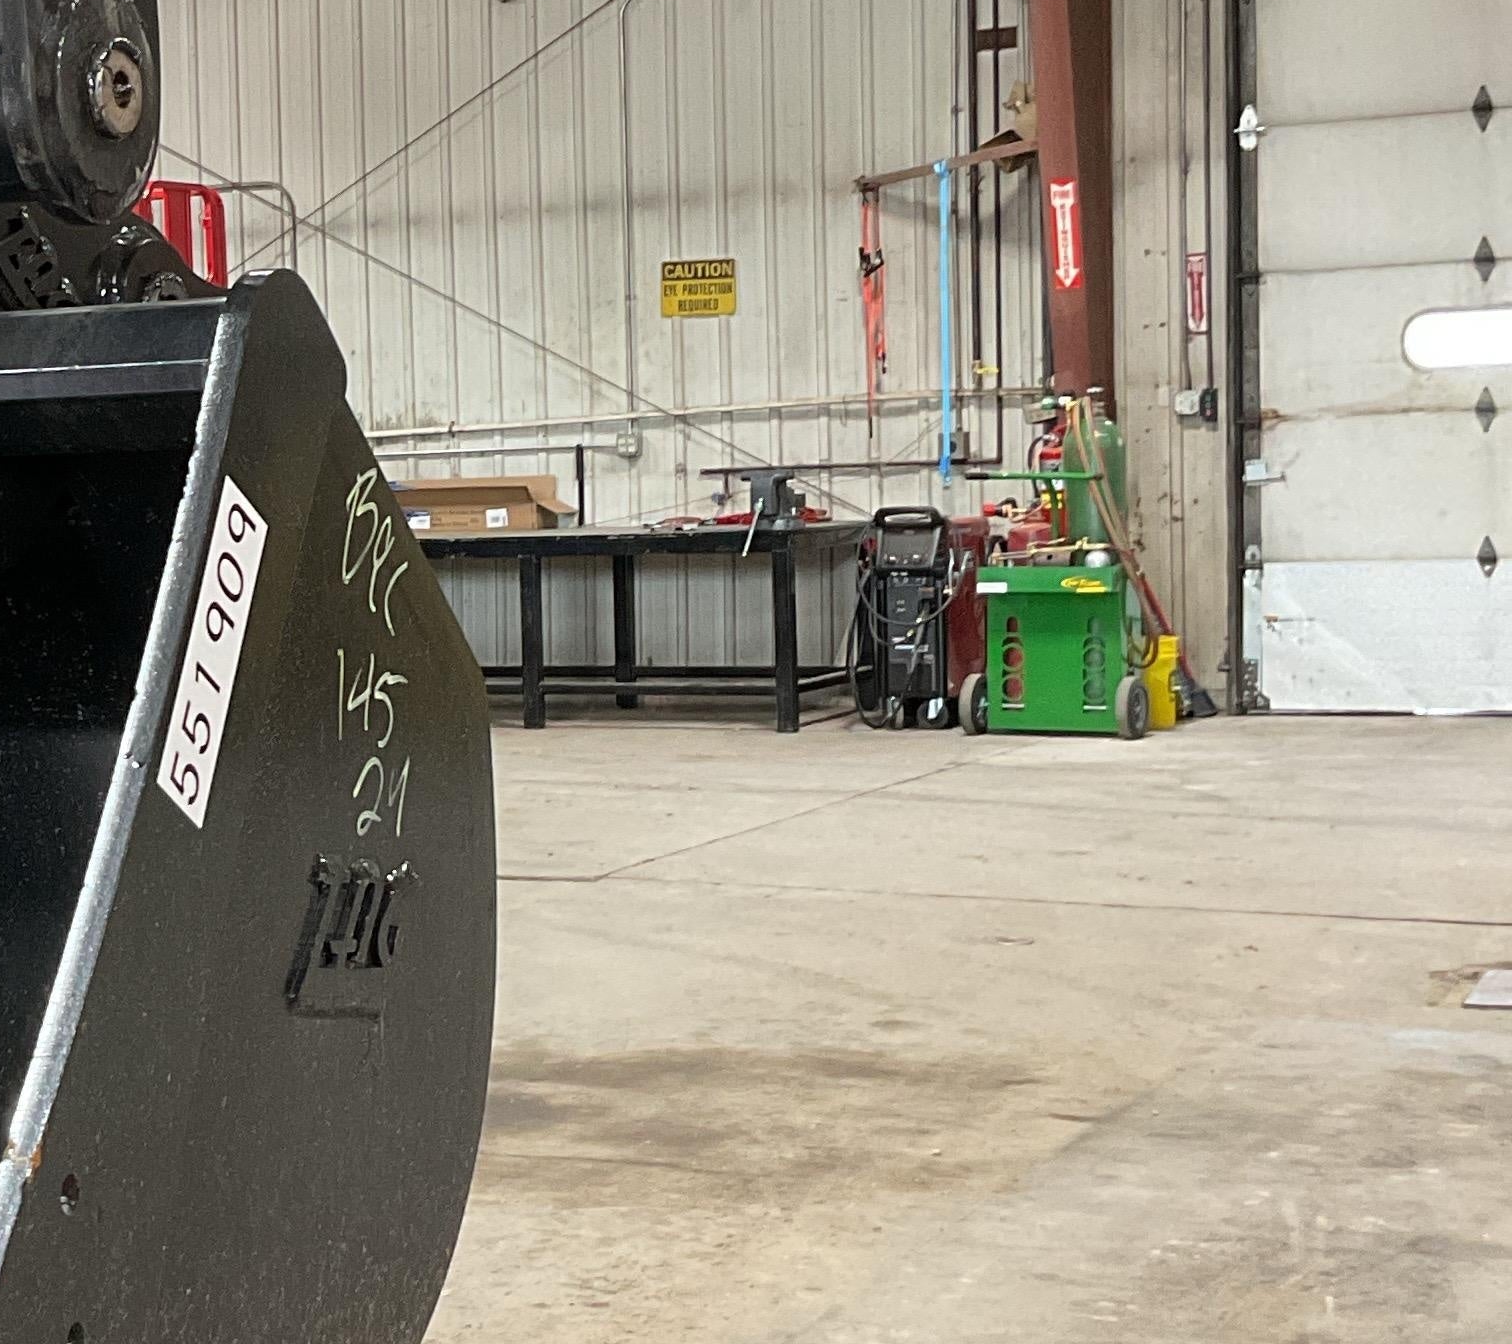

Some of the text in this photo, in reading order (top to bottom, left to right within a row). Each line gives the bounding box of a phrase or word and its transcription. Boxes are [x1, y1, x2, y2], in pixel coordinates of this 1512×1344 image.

[663, 261, 733, 279] CAUTION
[663, 281, 733, 297] EYE PROTECTION
[677, 298, 720, 312] REQUIRED
[169, 503, 257, 806] 551909
[337, 648, 409, 748] 145
